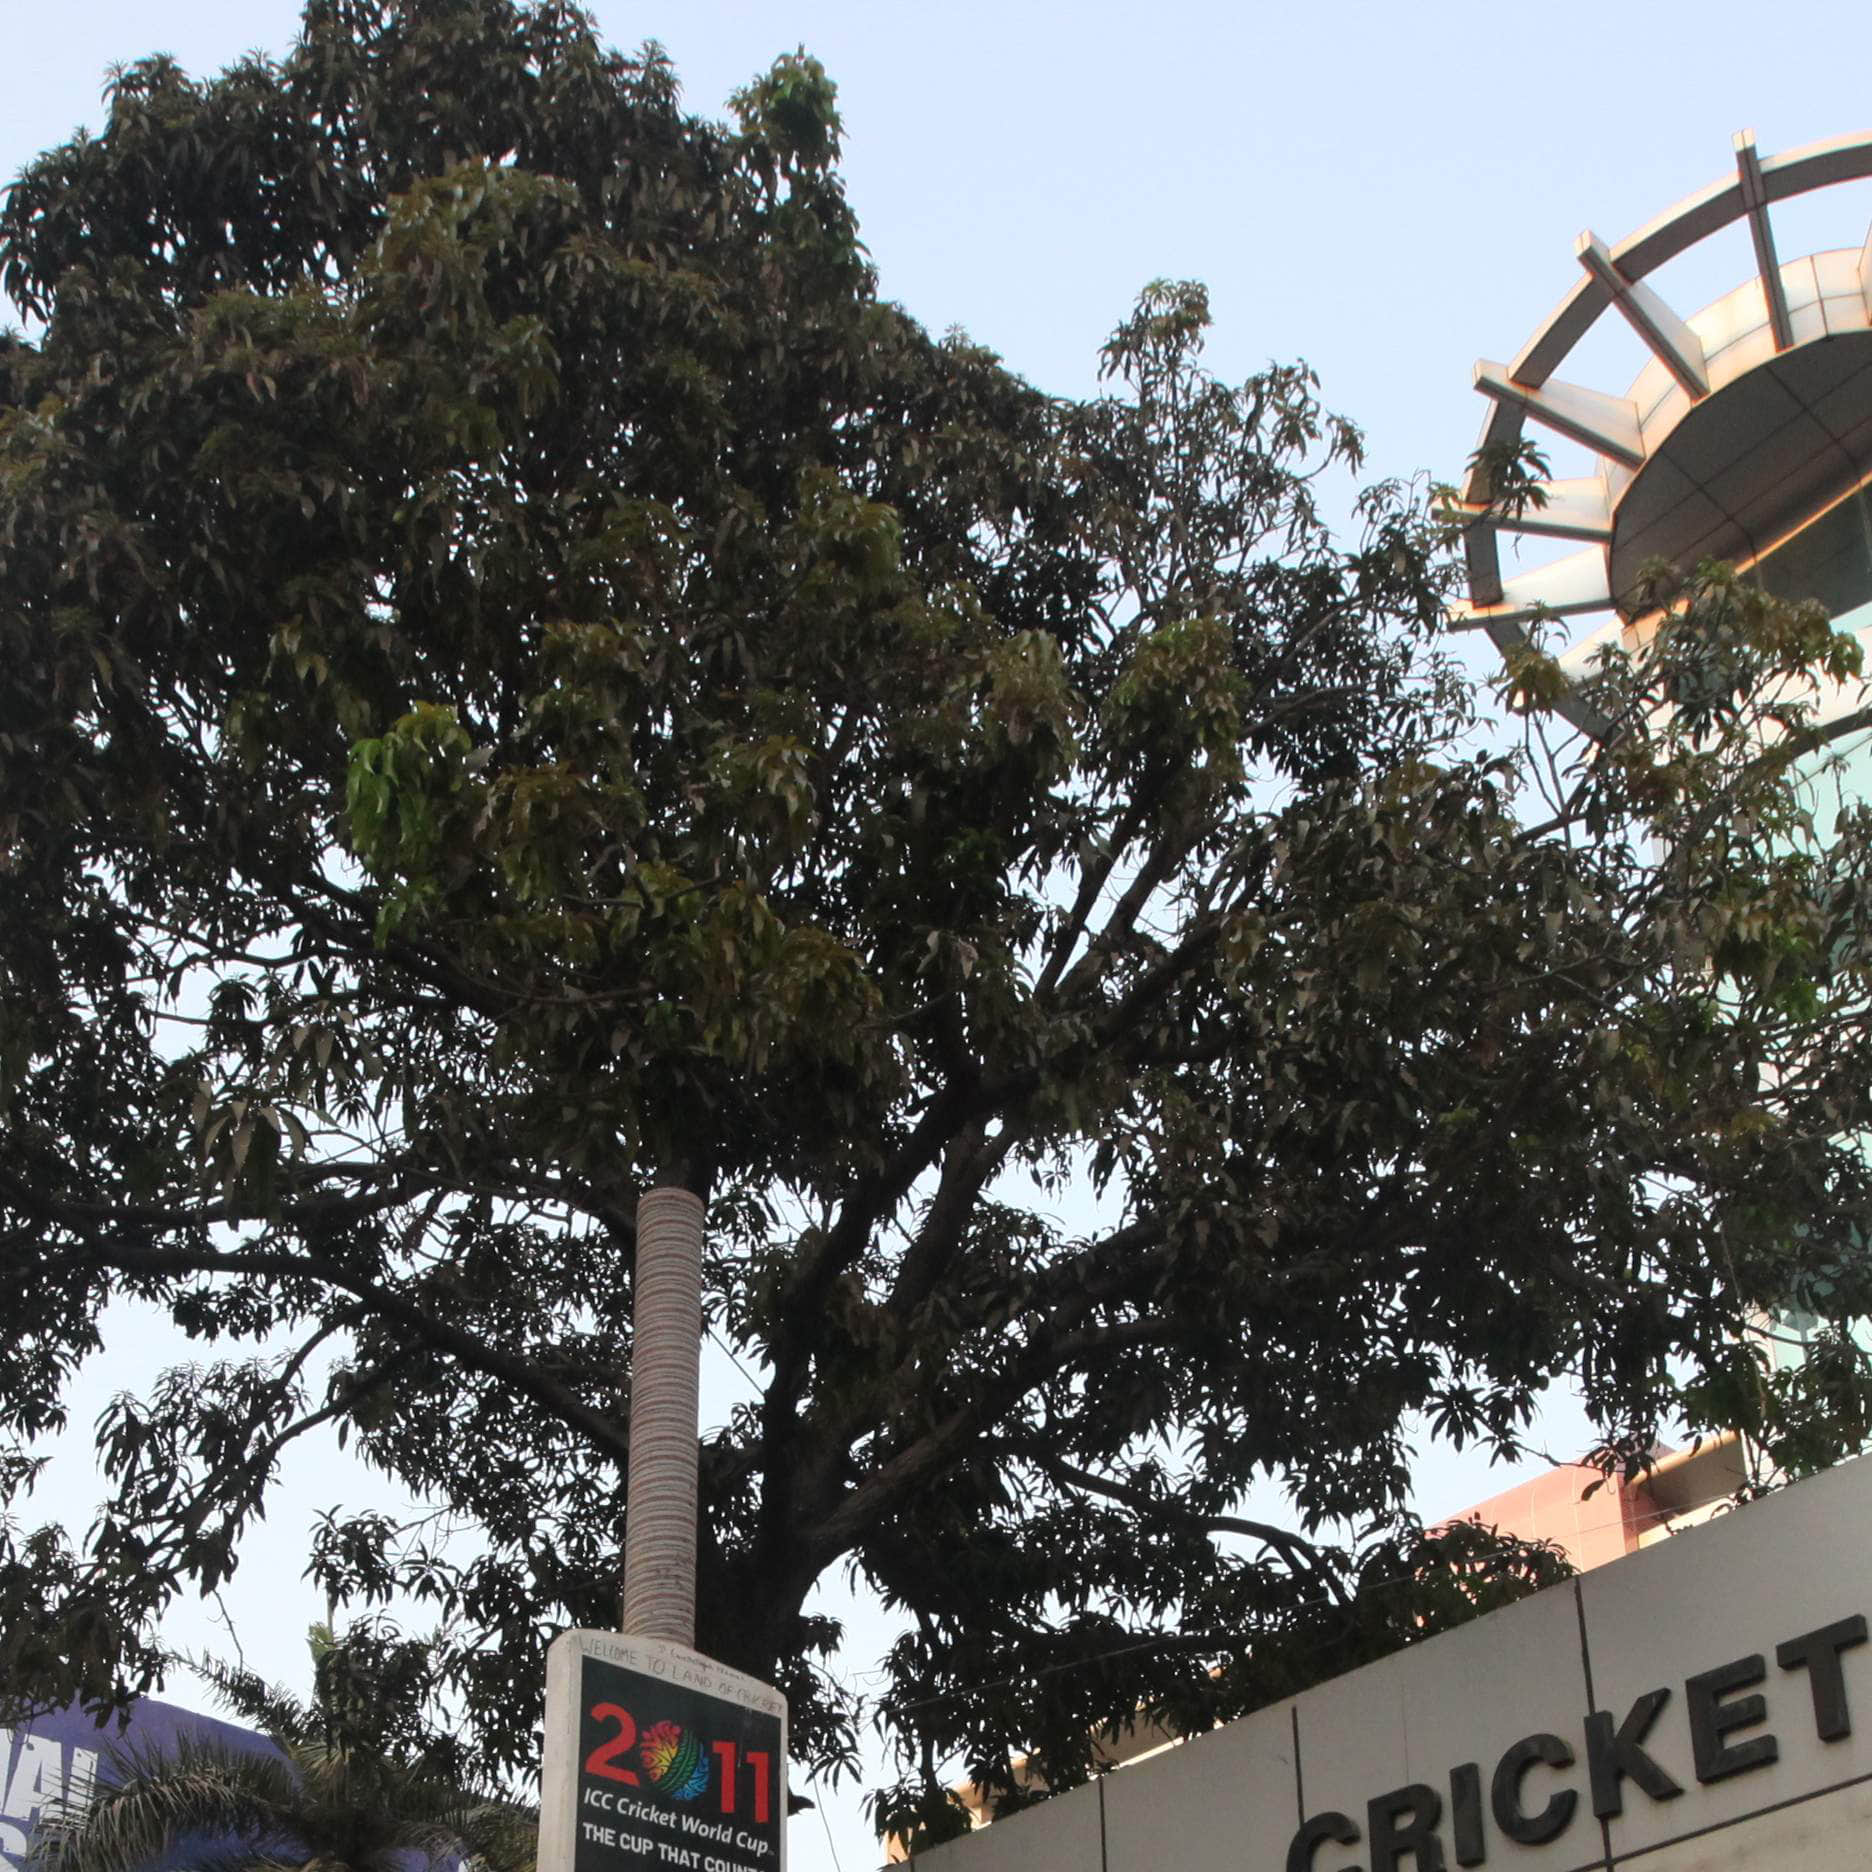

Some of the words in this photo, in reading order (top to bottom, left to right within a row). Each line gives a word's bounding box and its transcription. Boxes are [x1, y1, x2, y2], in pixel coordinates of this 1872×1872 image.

[582, 1822, 616, 1847] THE
[620, 1834, 654, 1855] CUP
[658, 1843, 700, 1869] THAT
[584, 1788, 612, 1811] ICC
[617, 1798, 677, 1829] Cricket
[681, 1814, 730, 1843] World
[735, 1831, 769, 1857] Cup
